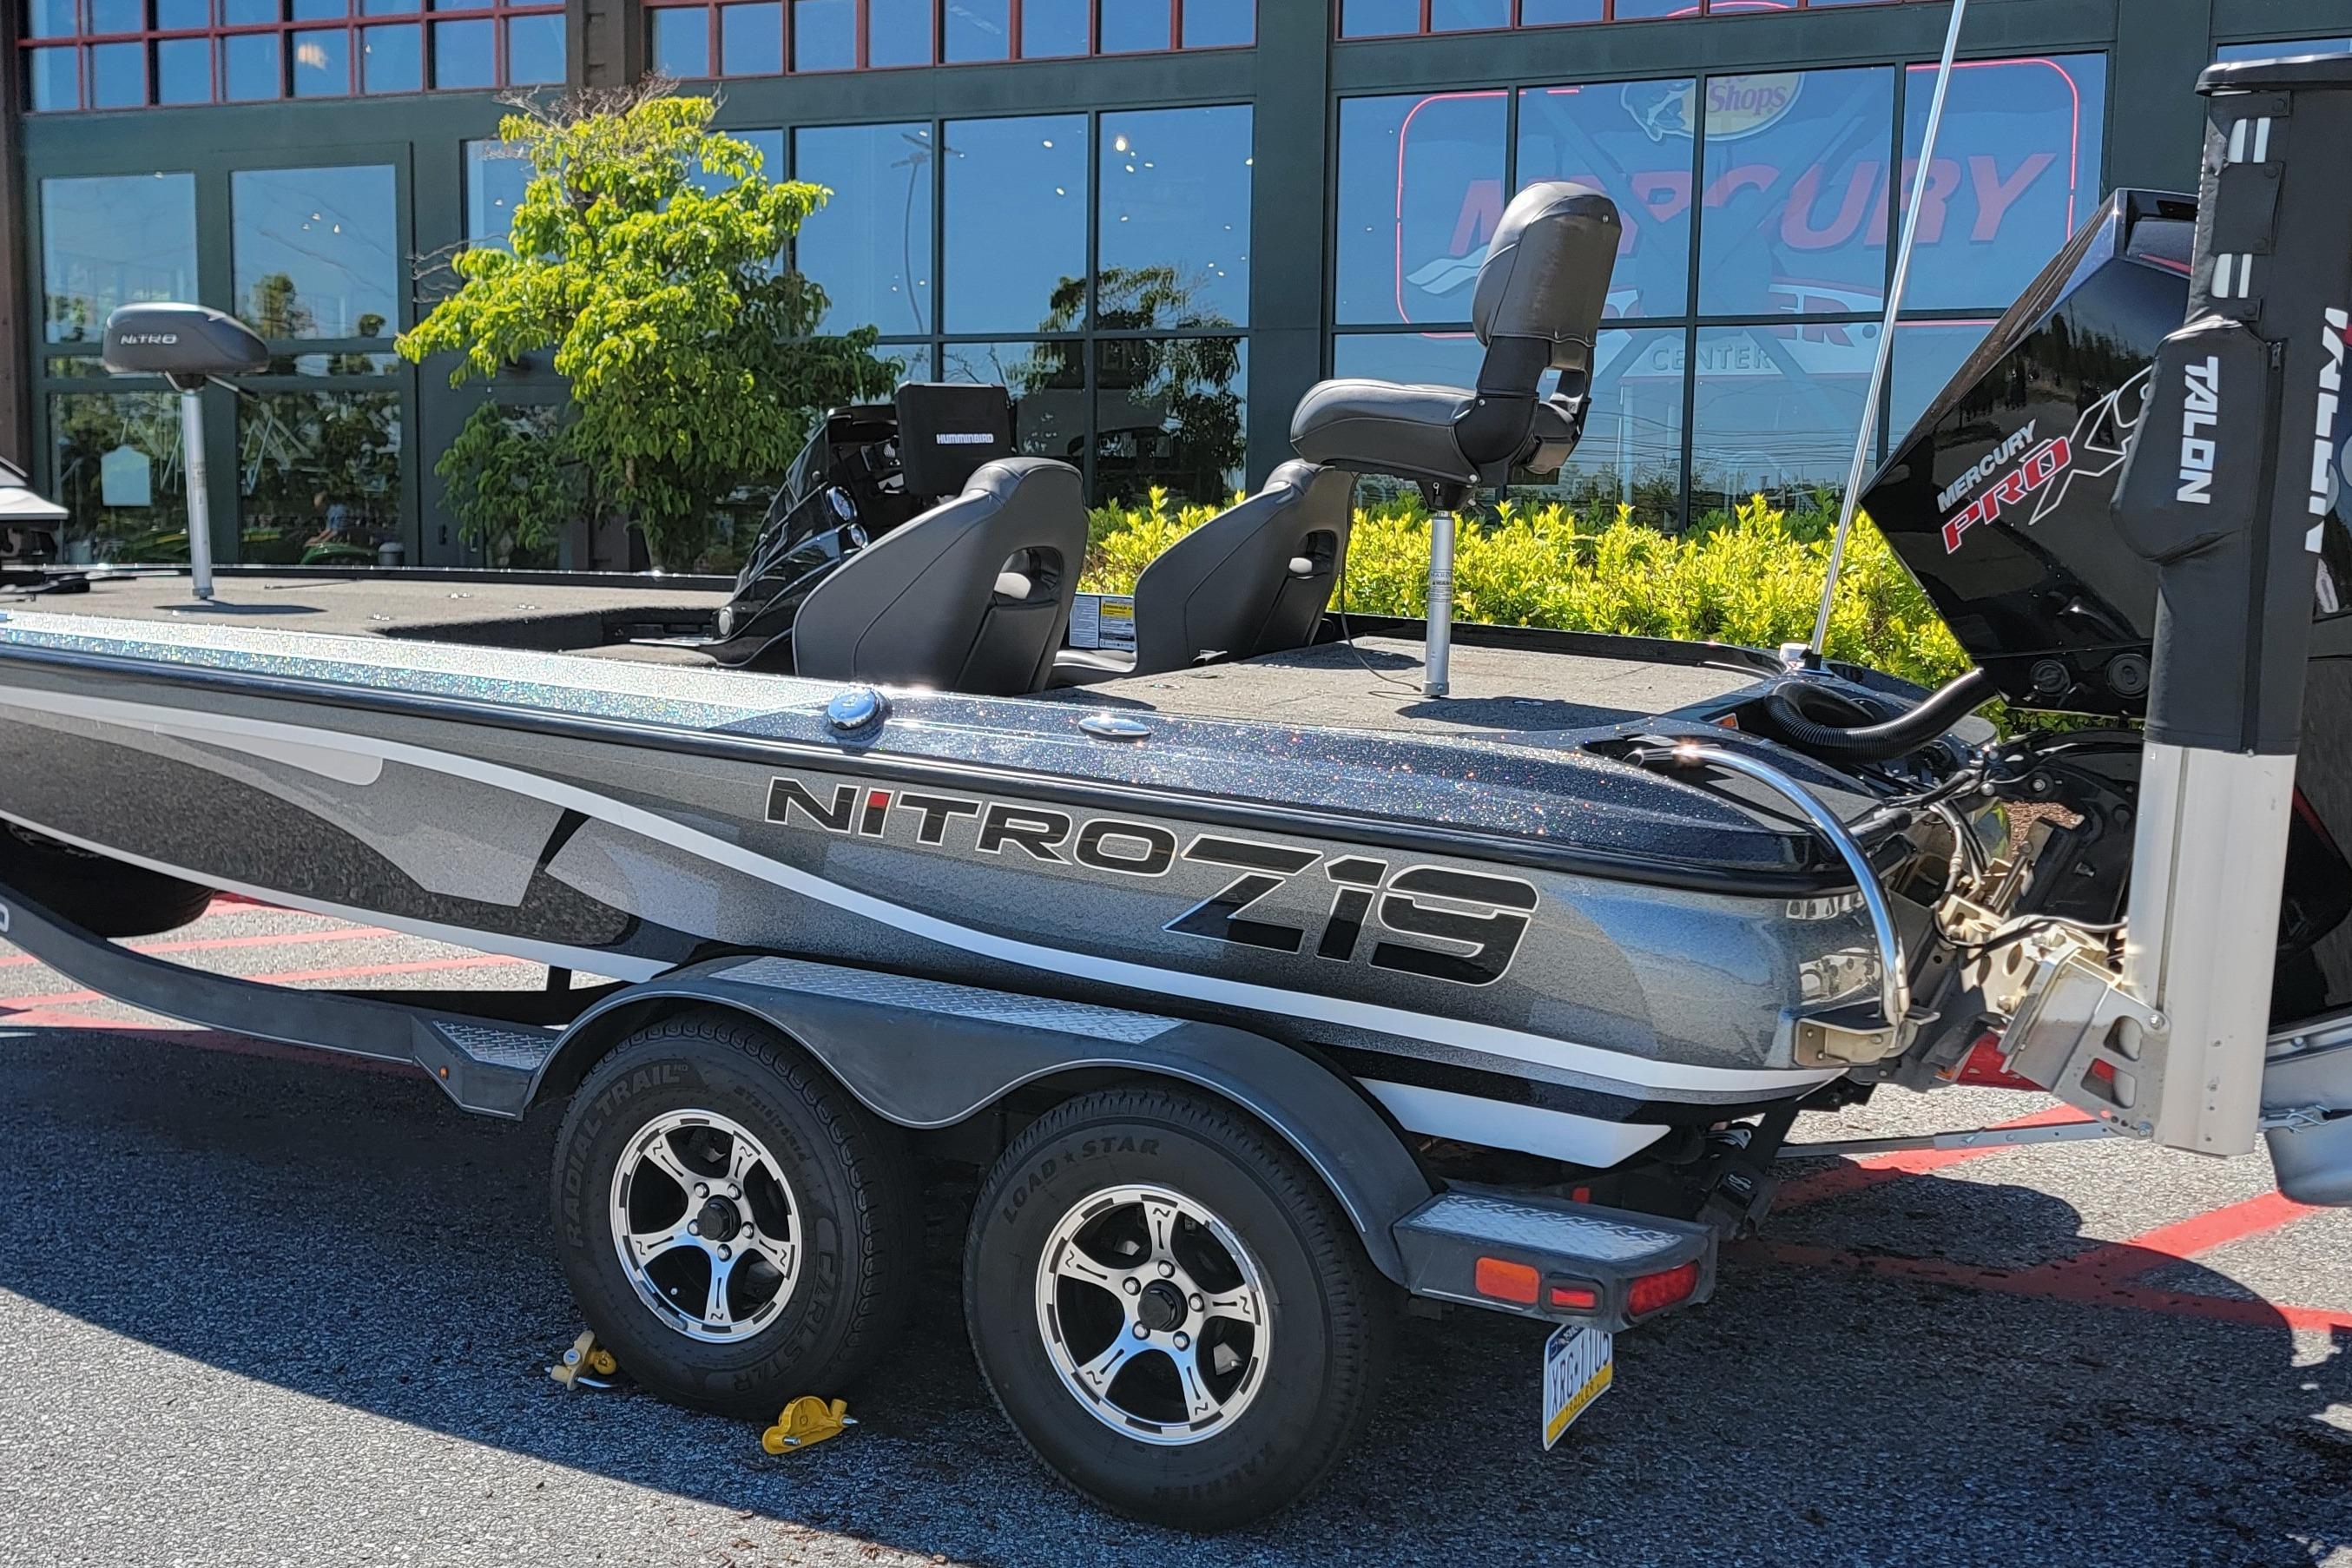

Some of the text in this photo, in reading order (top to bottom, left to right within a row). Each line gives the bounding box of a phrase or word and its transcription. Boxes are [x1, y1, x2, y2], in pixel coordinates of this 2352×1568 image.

[1707, 84, 1786, 115] Shops
[1448, 153, 2055, 258] MRCURY
[120, 333, 178, 345] NITRO
[1651, 345, 1772, 372] CENTER
[936, 433, 994, 445] HUMMINBIRD
[1937, 418, 2037, 513] MERCURY
[2177, 356, 2218, 504] TALON
[1941, 436, 2072, 555] PRO
[764, 775, 1540, 987] NITRO Z19
[566, 1117, 603, 1248] RADIAL
[596, 1063, 681, 1117] TRAIL
[1003, 1136, 1160, 1224] LOAD STAR
